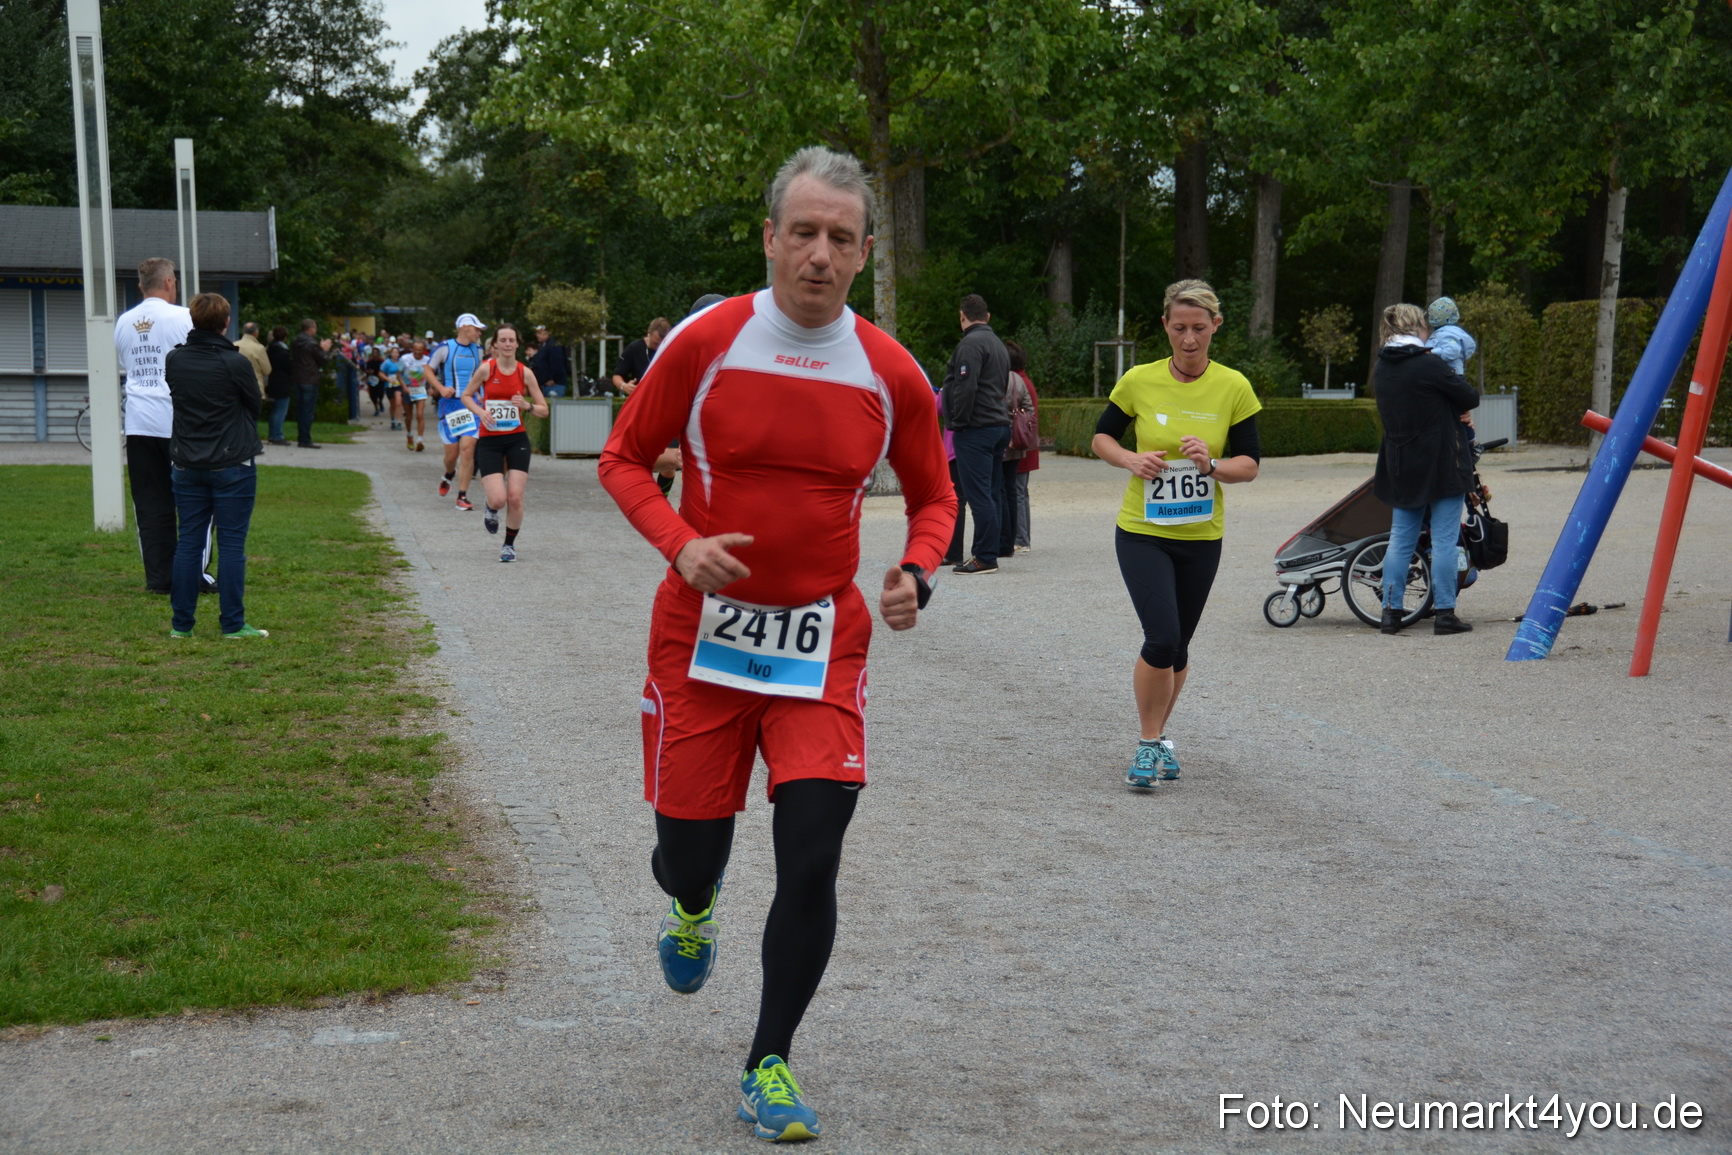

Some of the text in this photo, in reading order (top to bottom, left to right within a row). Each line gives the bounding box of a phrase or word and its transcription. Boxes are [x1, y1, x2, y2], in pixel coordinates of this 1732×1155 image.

[139, 333, 149, 342] IM
[135, 356, 158, 366] SEINER
[773, 353, 830, 371] saller
[450, 413, 472, 427] 2495
[490, 407, 517, 419] 2376
[1151, 475, 1209, 500] 2165
[1157, 504, 1203, 516] Alexandra
[713, 604, 822, 654] 2416
[747, 658, 772, 678] Ivo
